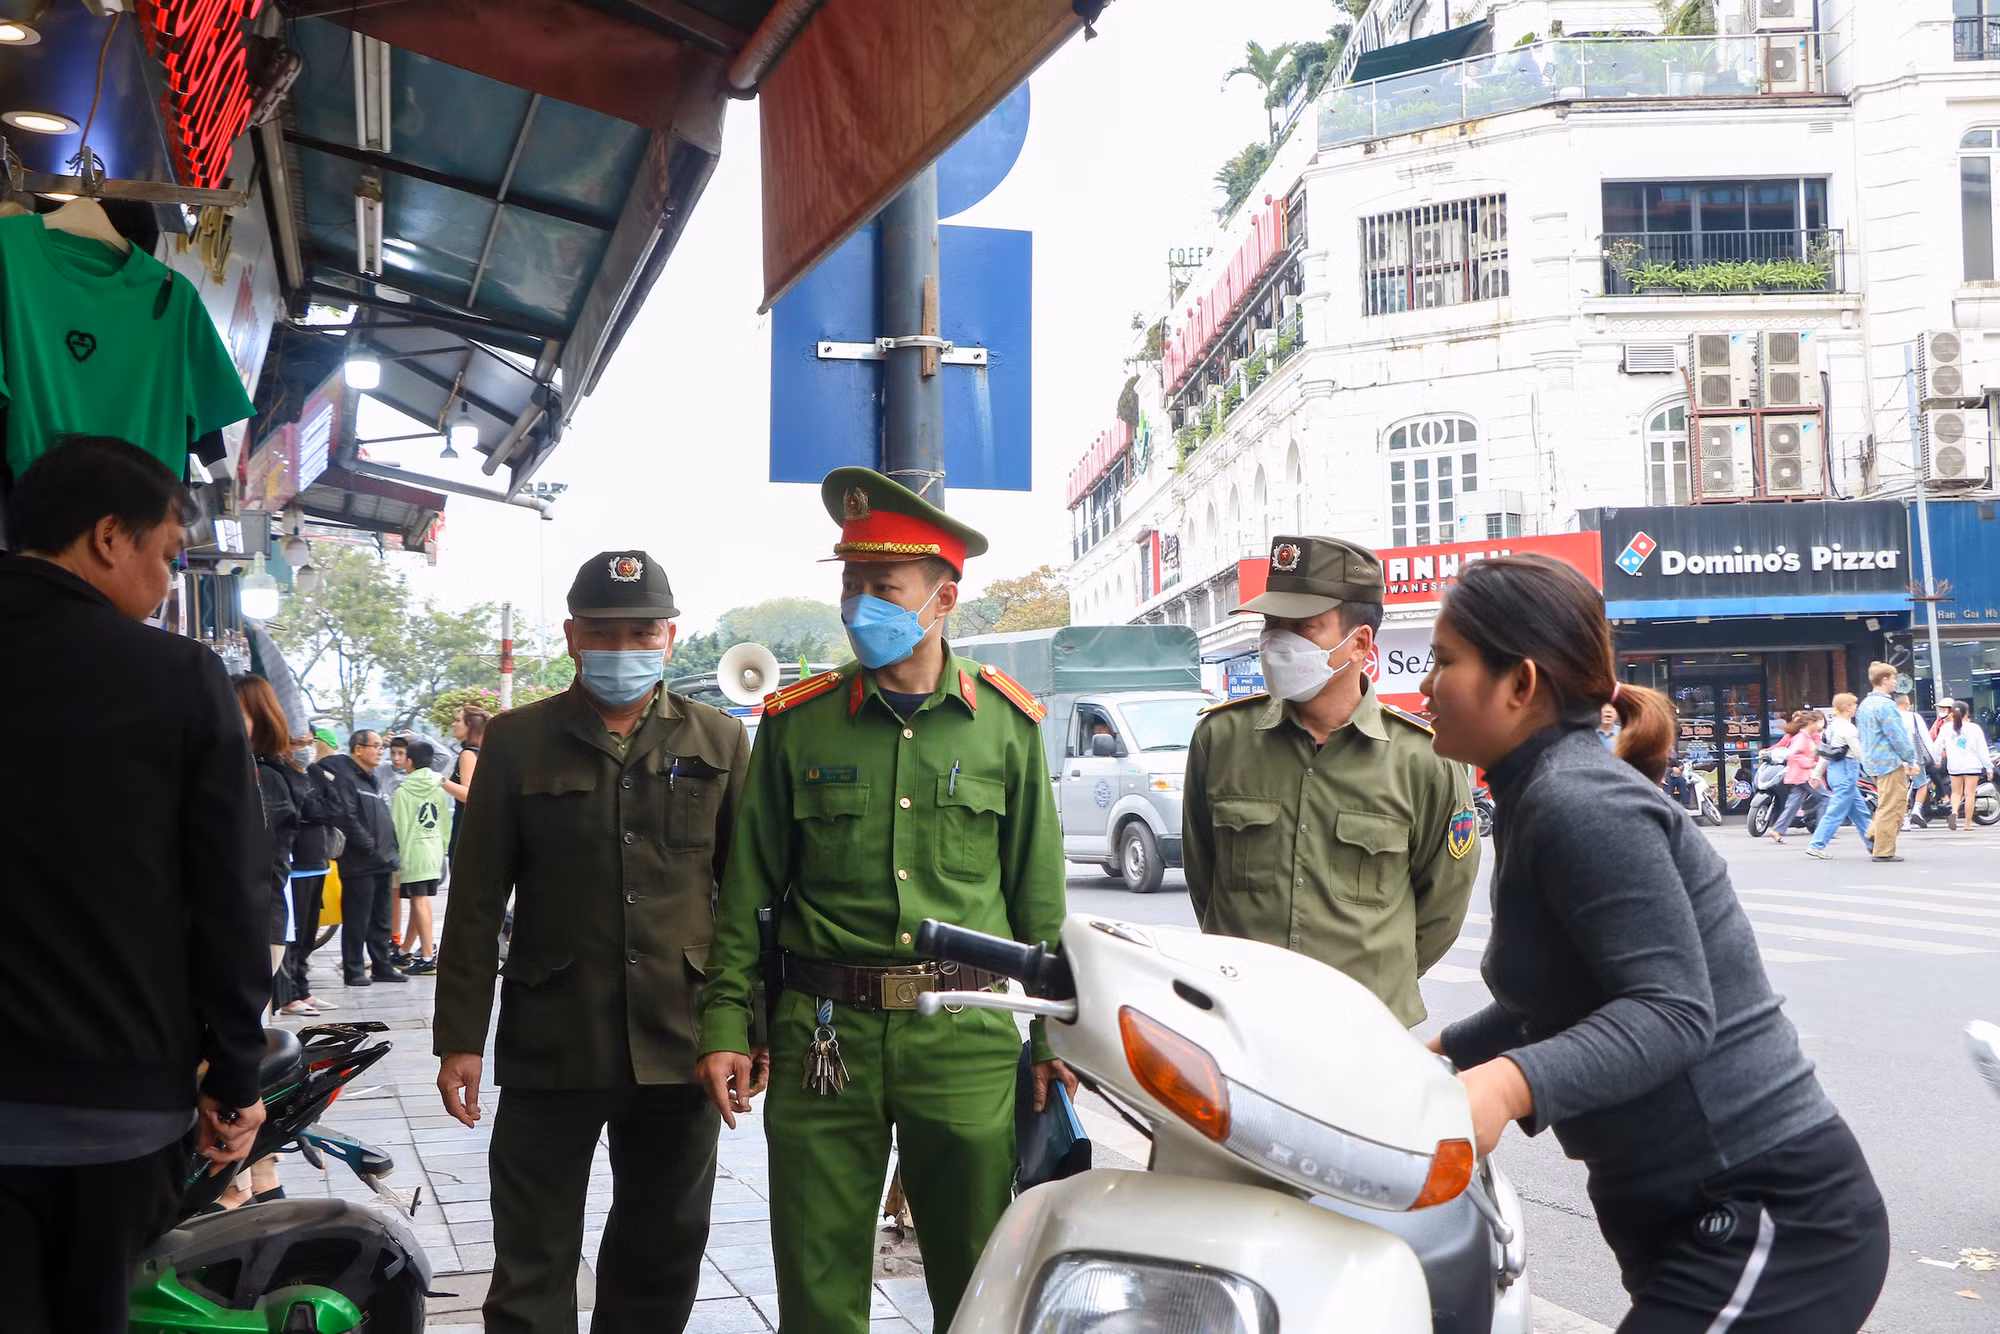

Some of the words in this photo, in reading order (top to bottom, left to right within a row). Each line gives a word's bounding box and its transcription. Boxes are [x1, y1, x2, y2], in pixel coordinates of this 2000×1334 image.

[1379, 549, 1512, 582] ANW
[1661, 545, 1801, 575] Domino's
[1811, 543, 1898, 571] Pizza
[1388, 649, 1436, 675] SeA
[1231, 683, 1251, 694] HÀNG
